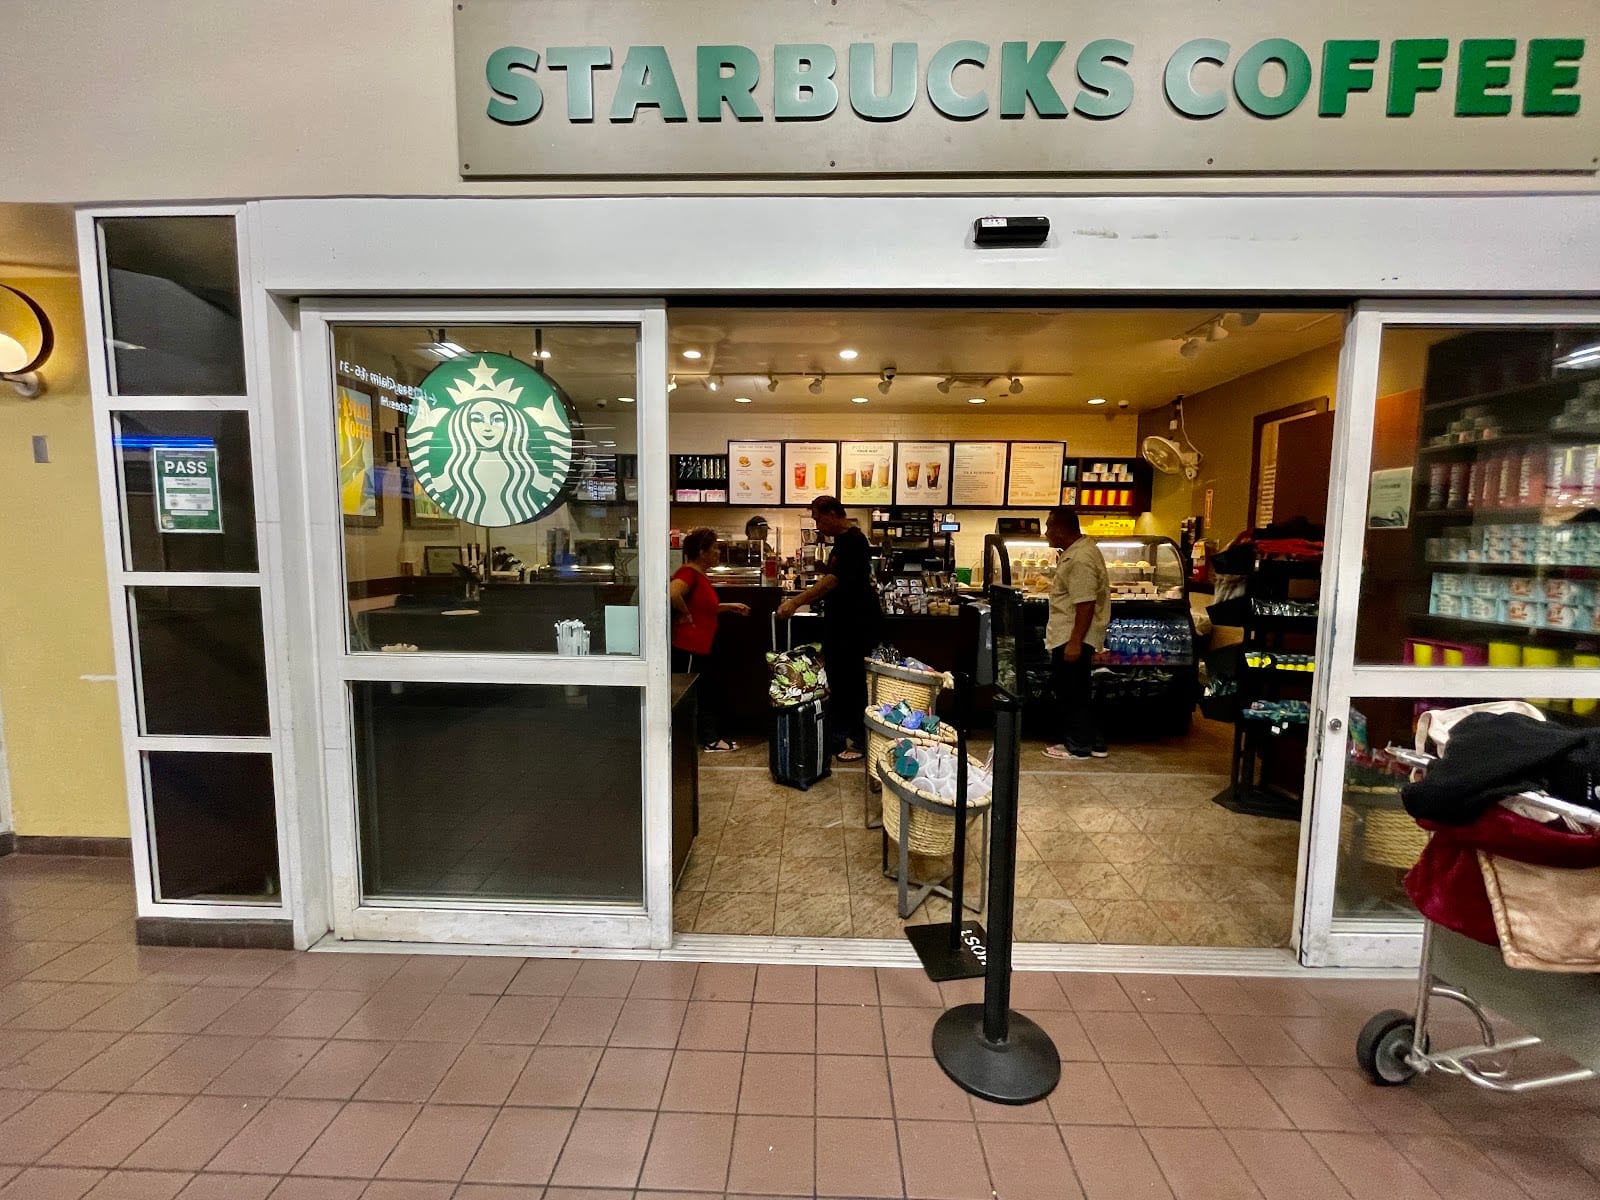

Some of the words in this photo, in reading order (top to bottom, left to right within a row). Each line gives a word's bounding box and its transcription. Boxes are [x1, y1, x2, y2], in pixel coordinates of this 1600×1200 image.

[486, 39, 1134, 125] STARBUCKS
[1164, 38, 1585, 118] COFFEE
[164, 460, 208, 474] PASS
